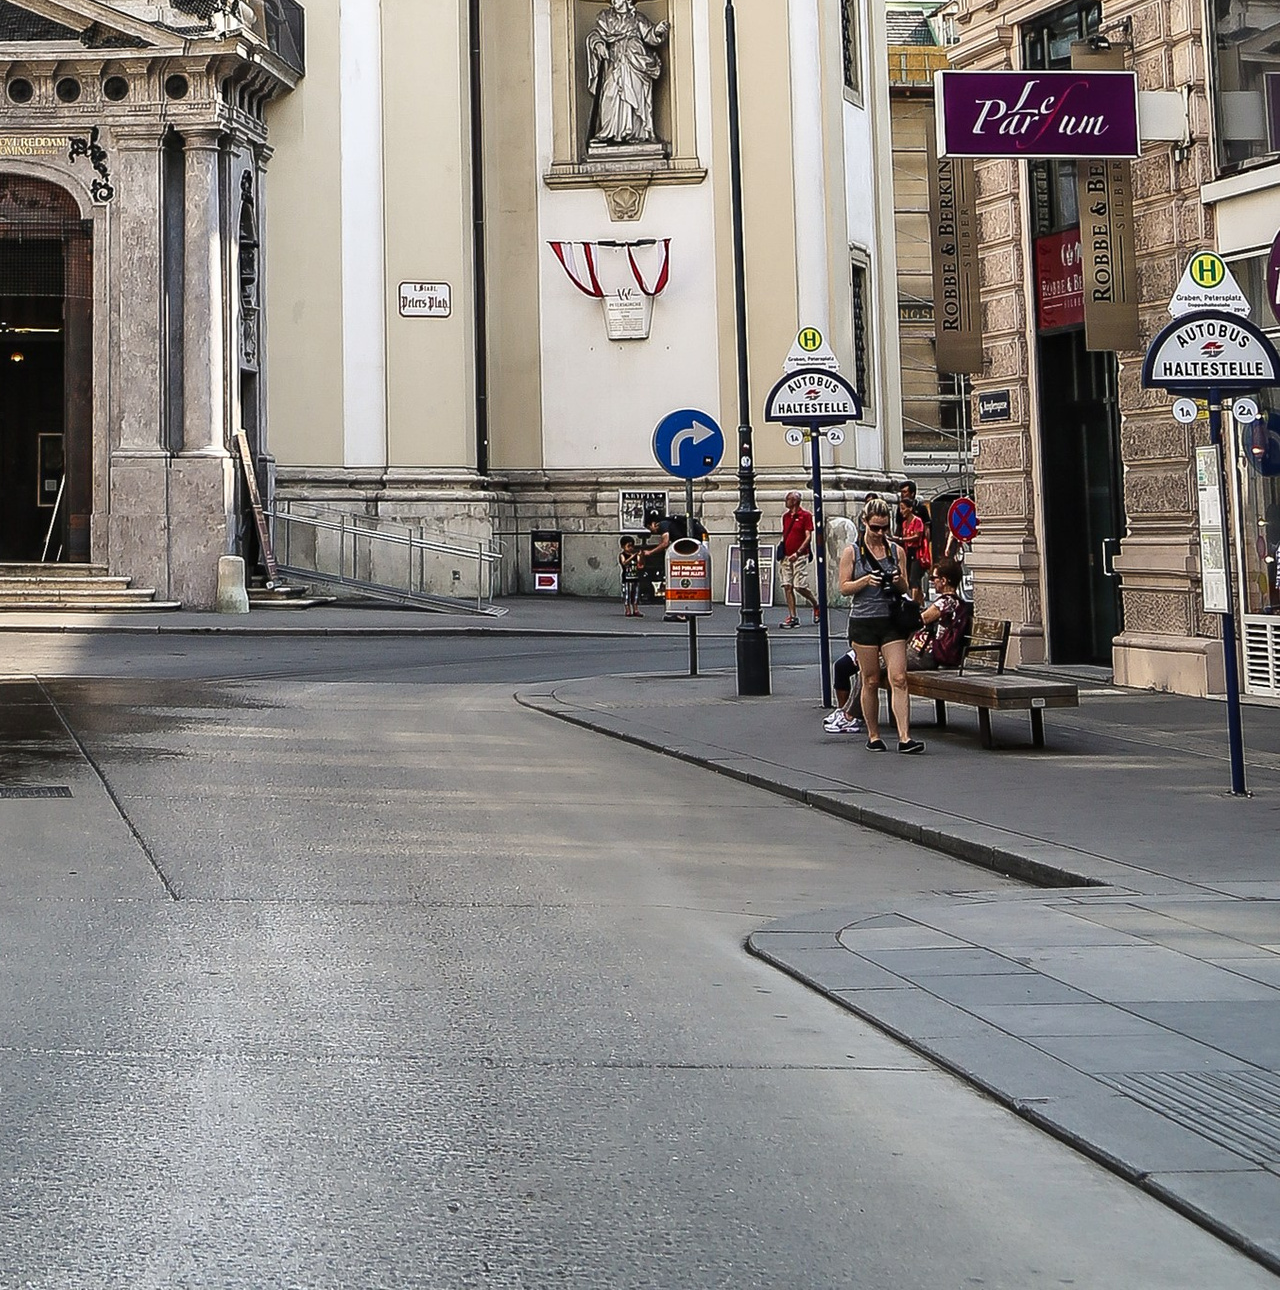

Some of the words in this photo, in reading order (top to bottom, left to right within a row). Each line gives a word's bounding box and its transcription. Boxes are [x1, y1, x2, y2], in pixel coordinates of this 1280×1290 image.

[1008, 80, 1055, 114] Le
[972, 81, 1109, 149] Parfum
[938, 159, 955, 238] BERKIN
[1090, 201, 1107, 217] &
[960, 207, 970, 268] SILBER
[941, 241, 956, 257] &
[1093, 224, 1113, 302] ROBBE
[1198, 259, 1217, 282] H
[943, 265, 959, 331] ROBBE
[1176, 294, 1202, 302] Graben,
[1204, 294, 1241, 303] Petersplatz
[804, 332, 816, 347] H
[1176, 322, 1250, 349] AUTOBUS
[1163, 362, 1264, 377] HALTESTELLE
[787, 375, 839, 394] AUTOBUS
[778, 402, 849, 414] HALTESTELLE
[1179, 407, 1192, 418] 1A
[1238, 405, 1253, 416] 2A
[790, 434, 799, 442] 1A
[831, 432, 841, 440] 2A
